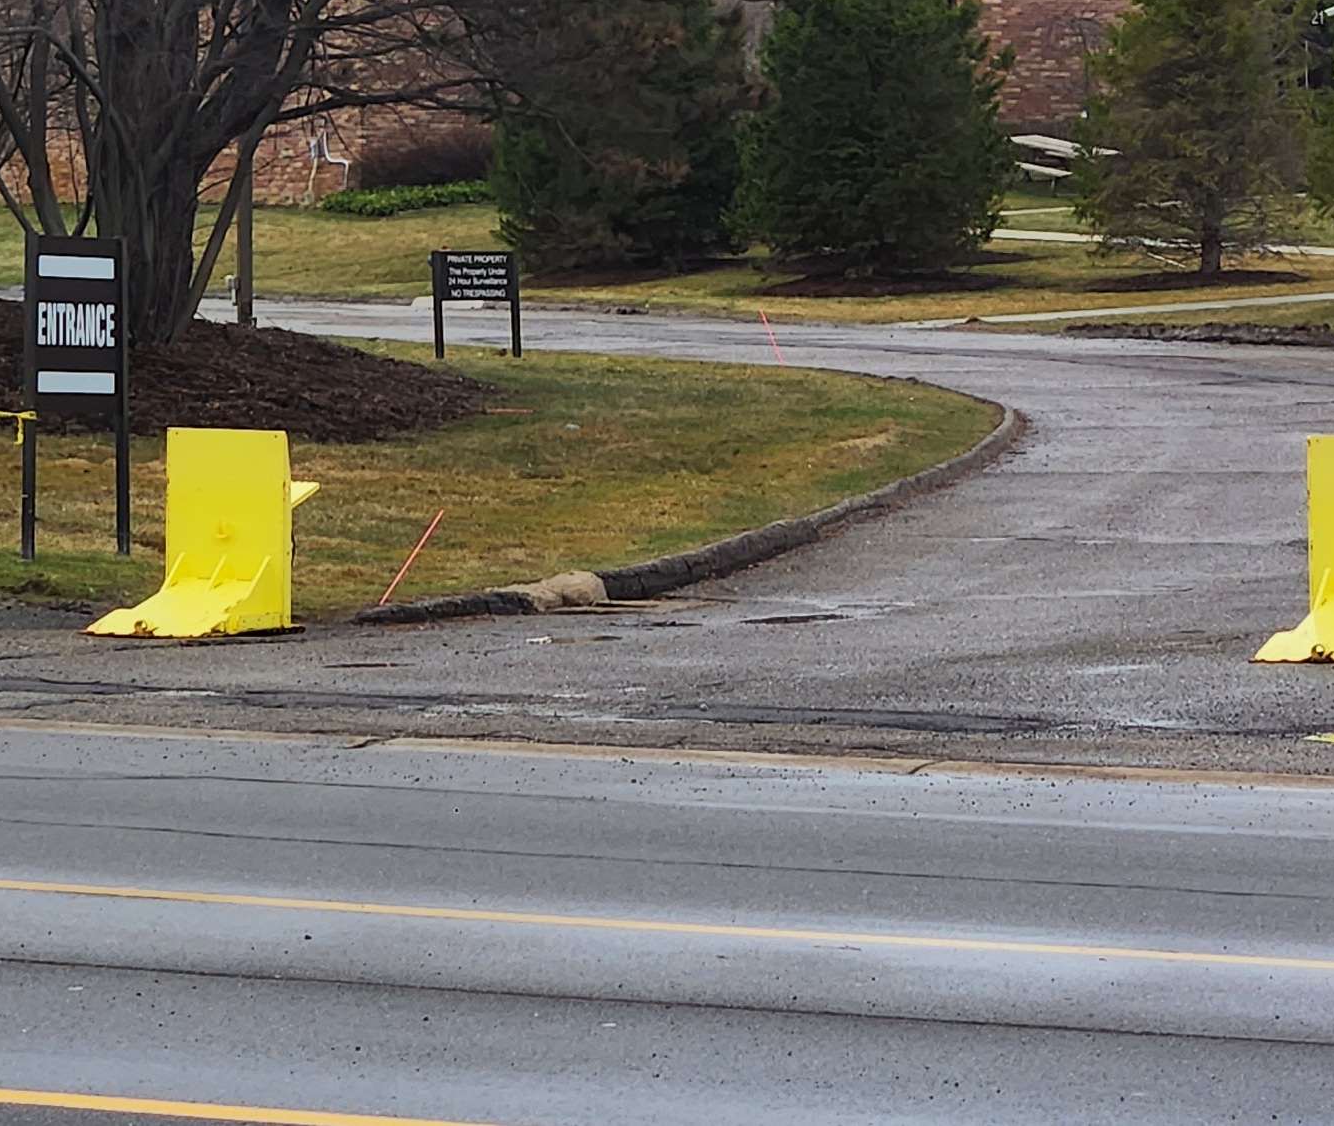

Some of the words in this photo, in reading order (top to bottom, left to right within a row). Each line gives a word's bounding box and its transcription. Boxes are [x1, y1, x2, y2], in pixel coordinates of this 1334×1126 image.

[447, 254, 473, 264] PRIVATE
[474, 254, 508, 264] PROPERTY
[463, 267, 487, 277] Property
[488, 267, 507, 275] Under
[448, 277, 456, 286] 24
[451, 289, 462, 298] NO
[463, 288, 506, 298] TRESPASSING
[37, 302, 115, 348] ENTRANCE
